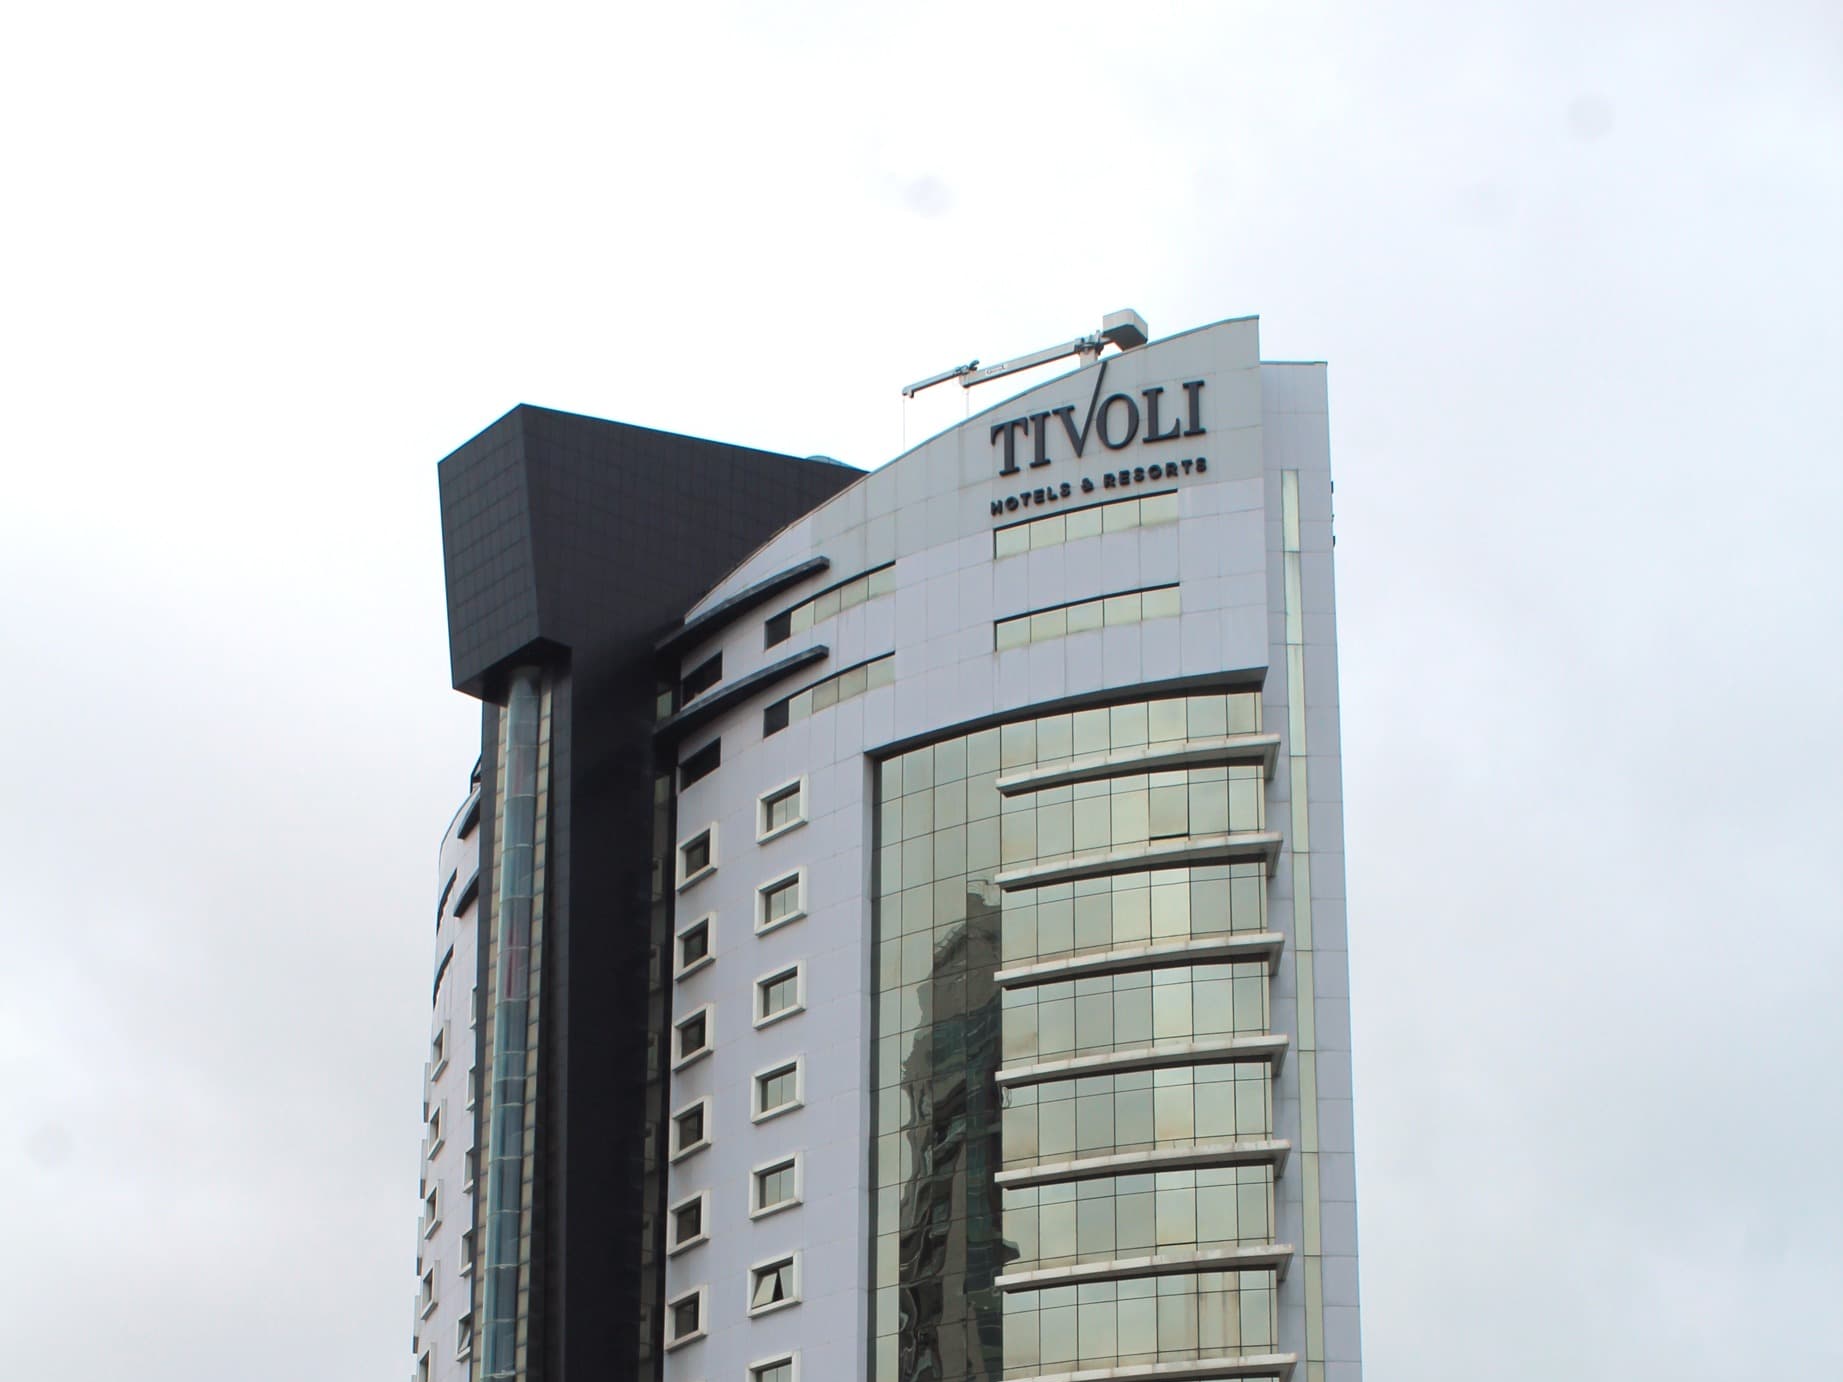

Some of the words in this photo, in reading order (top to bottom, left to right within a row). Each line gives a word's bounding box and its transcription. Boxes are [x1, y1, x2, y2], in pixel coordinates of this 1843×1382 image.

[990, 360, 1207, 477] TIVOLI
[990, 482, 1072, 517] HOTELS
[1080, 477, 1095, 494] &
[1103, 457, 1208, 489] RESORTS
